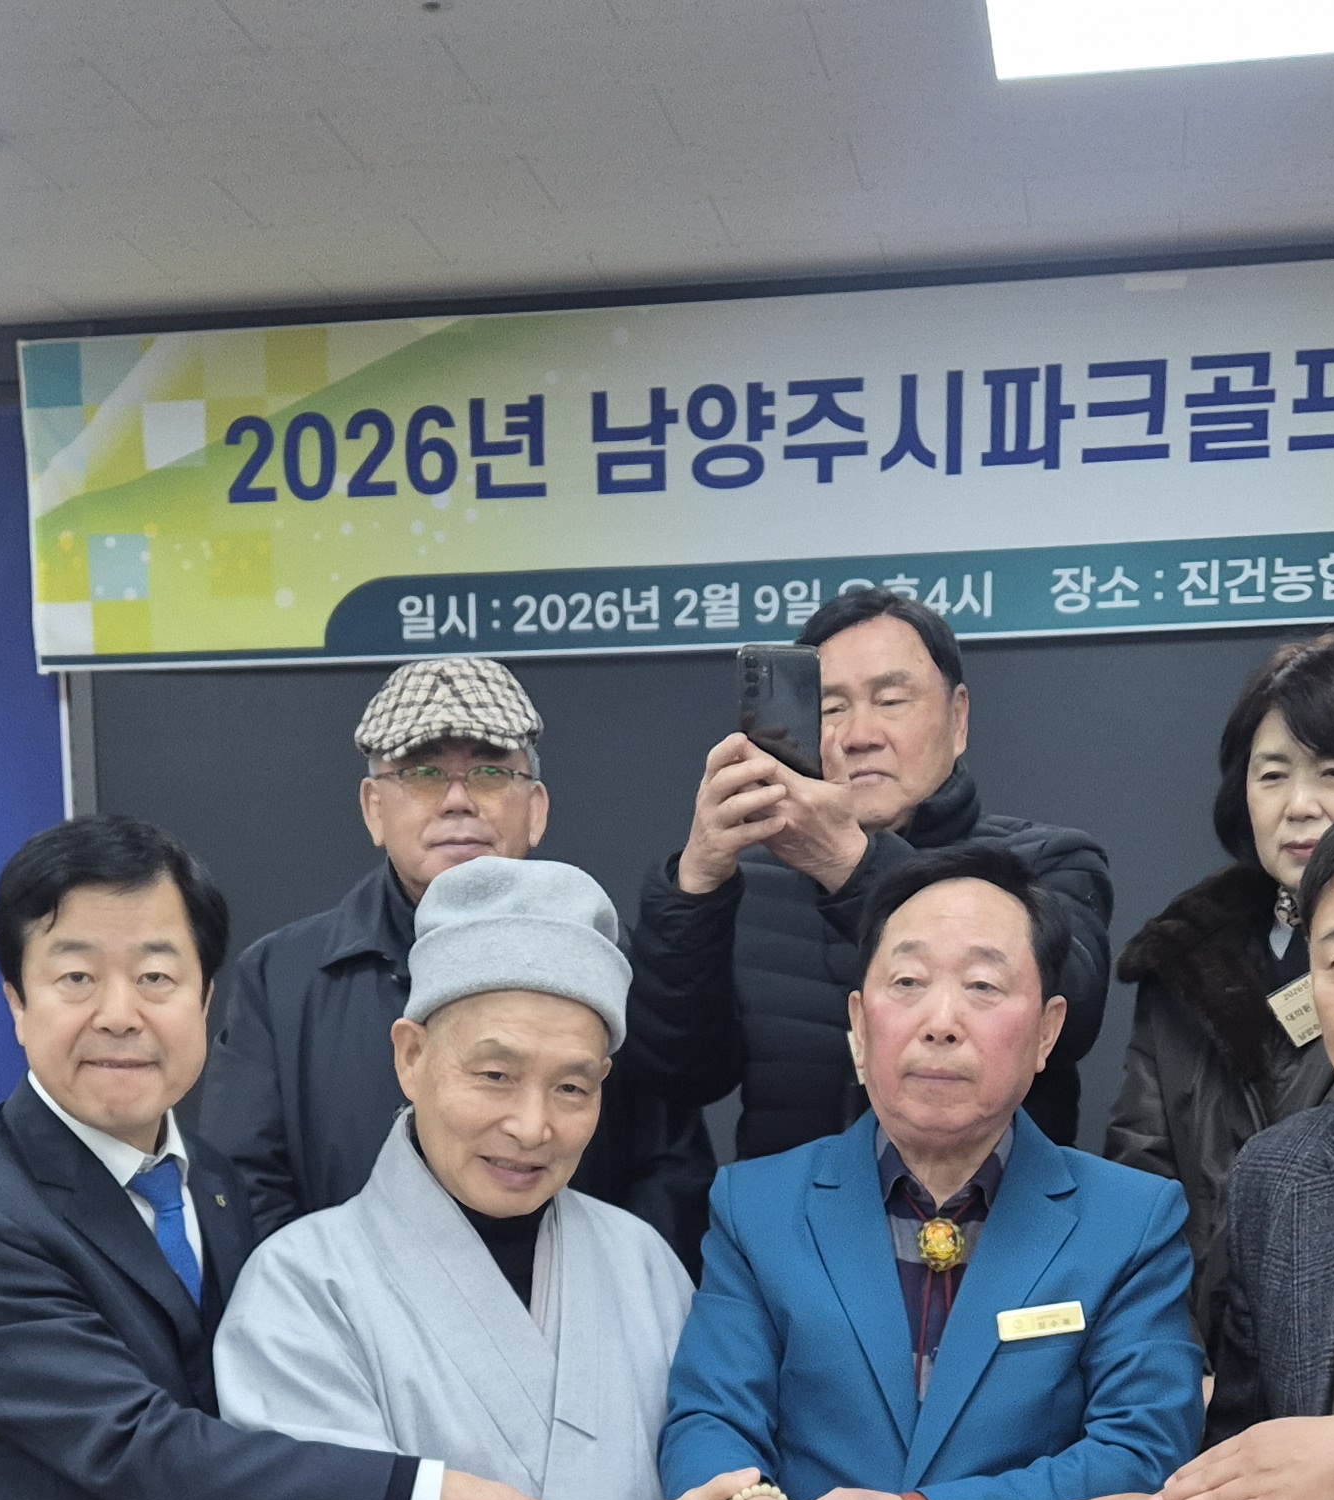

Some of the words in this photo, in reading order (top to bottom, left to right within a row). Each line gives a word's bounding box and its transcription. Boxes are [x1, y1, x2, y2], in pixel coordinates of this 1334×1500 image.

[224, 393, 547, 504] 2026년
[398, 592, 478, 640] 일시
[512, 585, 660, 633] 2026년
[672, 581, 742, 629] 2월
[753, 577, 821, 625] 9일
[1050, 564, 1141, 614] 장소
